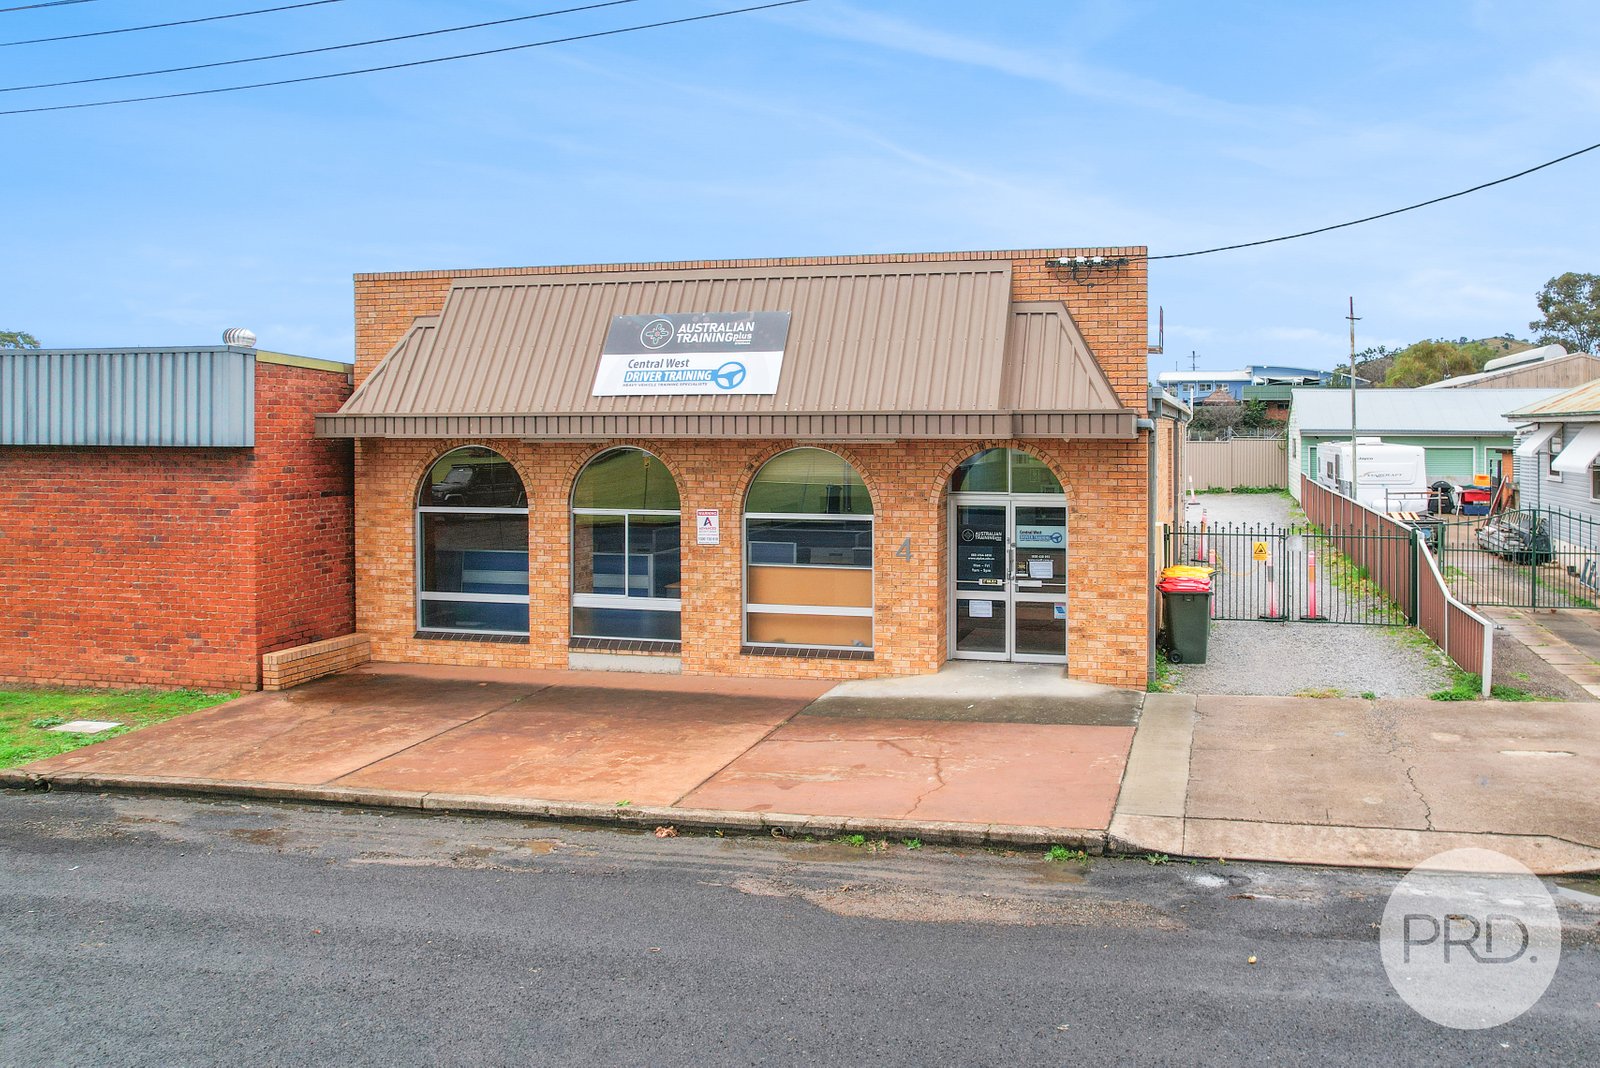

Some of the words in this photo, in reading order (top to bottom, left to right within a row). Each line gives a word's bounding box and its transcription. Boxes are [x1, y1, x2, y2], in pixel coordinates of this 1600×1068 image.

[678, 322, 755, 333] AUSTRALIAN
[628, 359, 663, 369] Central
[666, 358, 689, 368] West
[625, 371, 662, 382] DRIVER
[664, 370, 712, 381] TRAINING
[703, 517, 713, 526] A
[896, 537, 913, 562] 4
